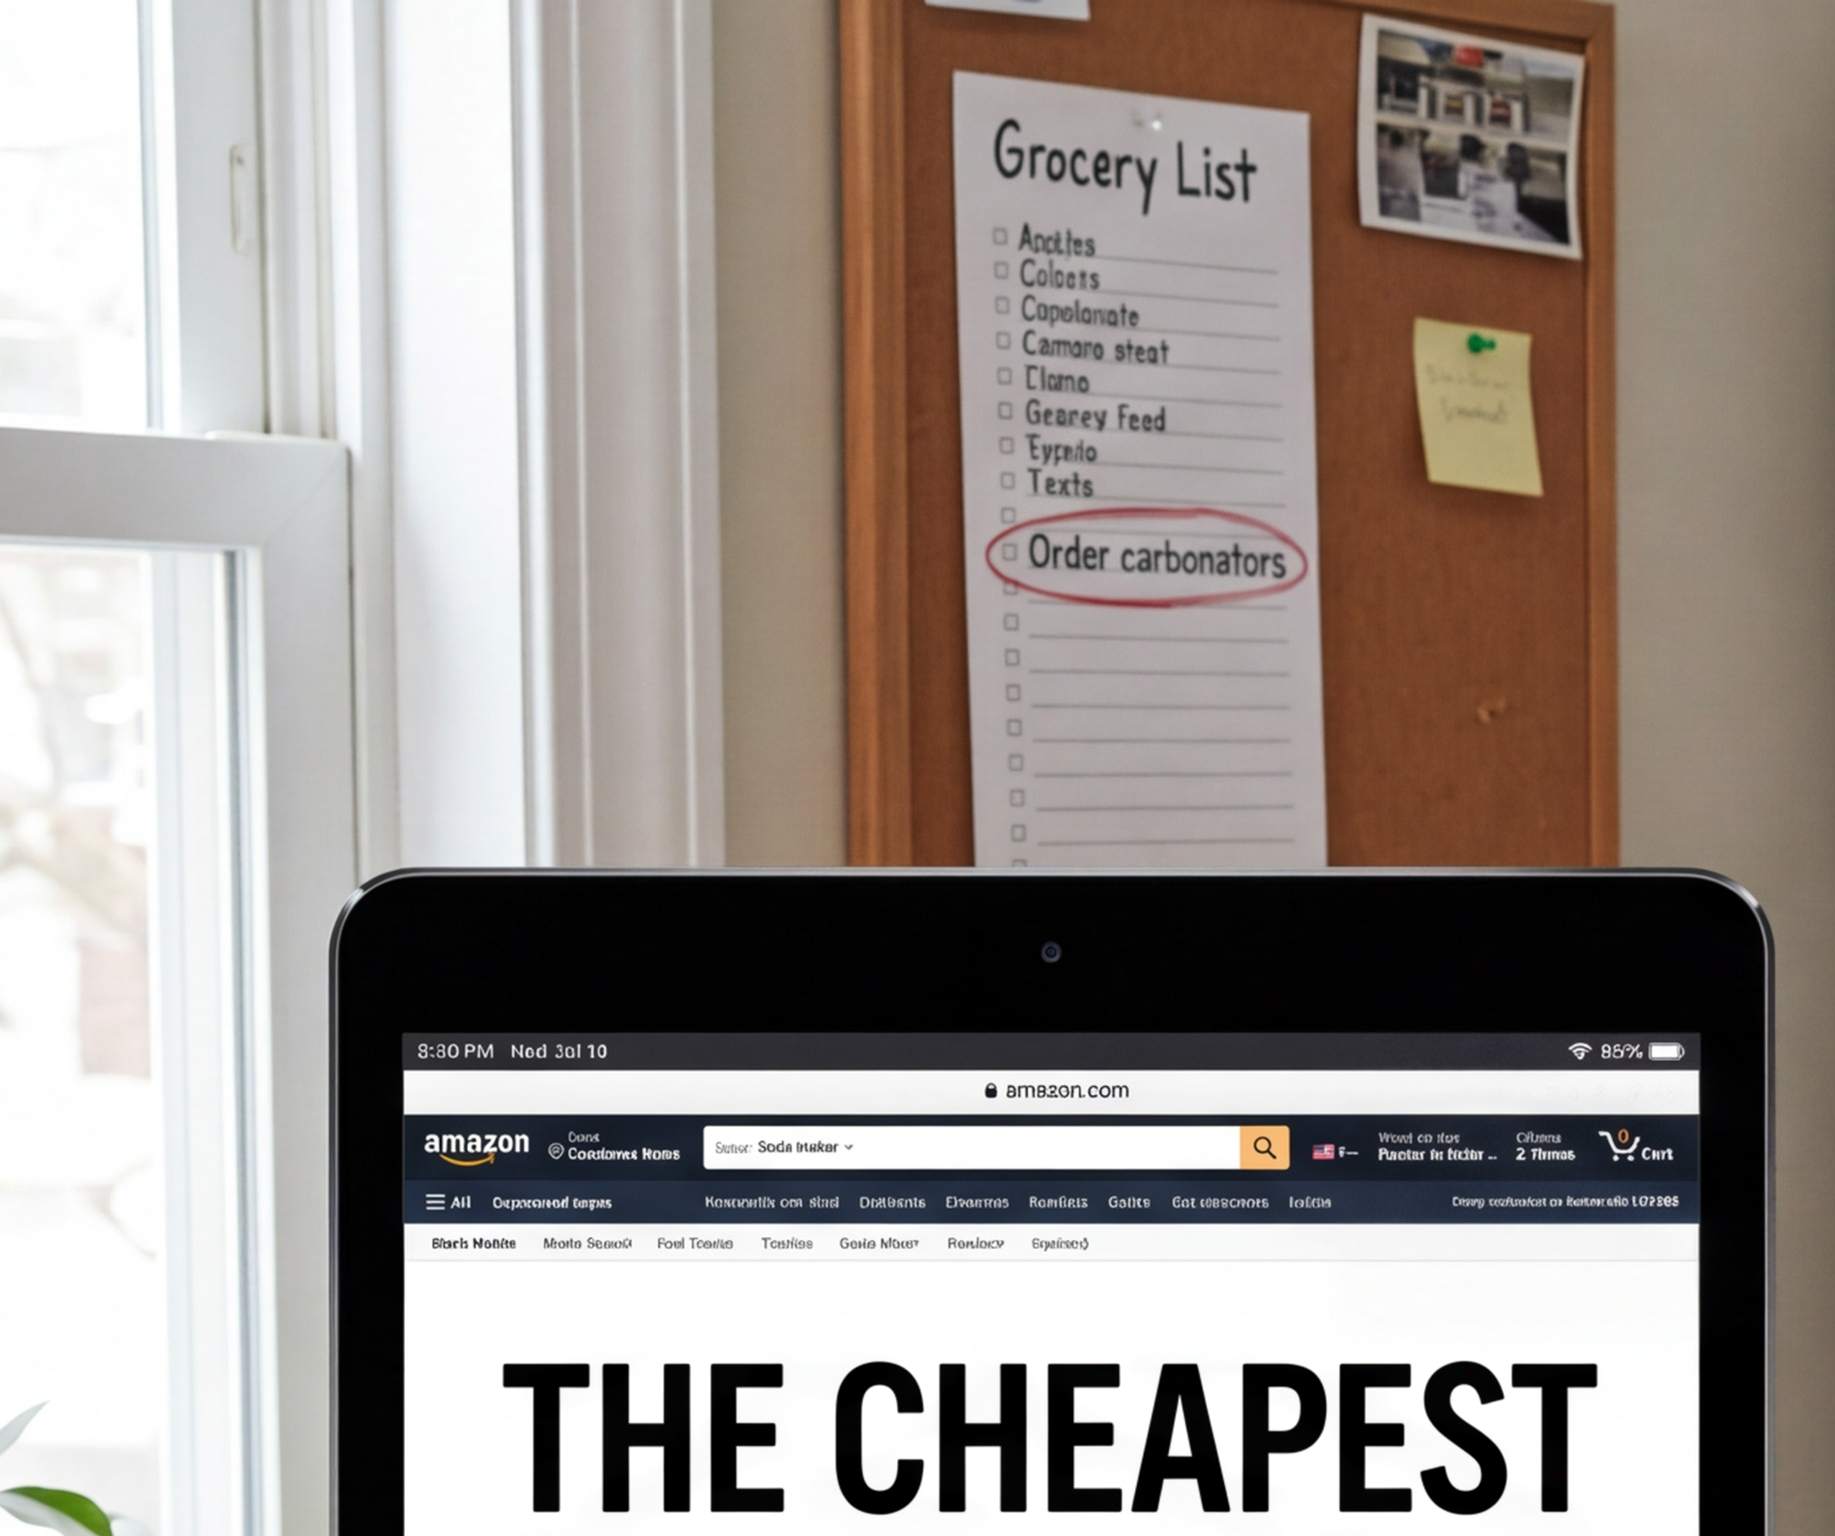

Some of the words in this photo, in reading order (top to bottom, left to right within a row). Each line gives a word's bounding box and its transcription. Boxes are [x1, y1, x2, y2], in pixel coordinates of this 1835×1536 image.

[993, 118, 1158, 216] Grocery
[1177, 140, 1258, 203] List
[1028, 533, 1110, 570] Order
[1120, 540, 1287, 578] carbonators
[464, 1043, 495, 1060] PM
[587, 1043, 608, 1060] 10
[424, 1132, 530, 1153] amazon
[502, 1362, 785, 1512] THE
[834, 1360, 1599, 1515] CHEAPEST
